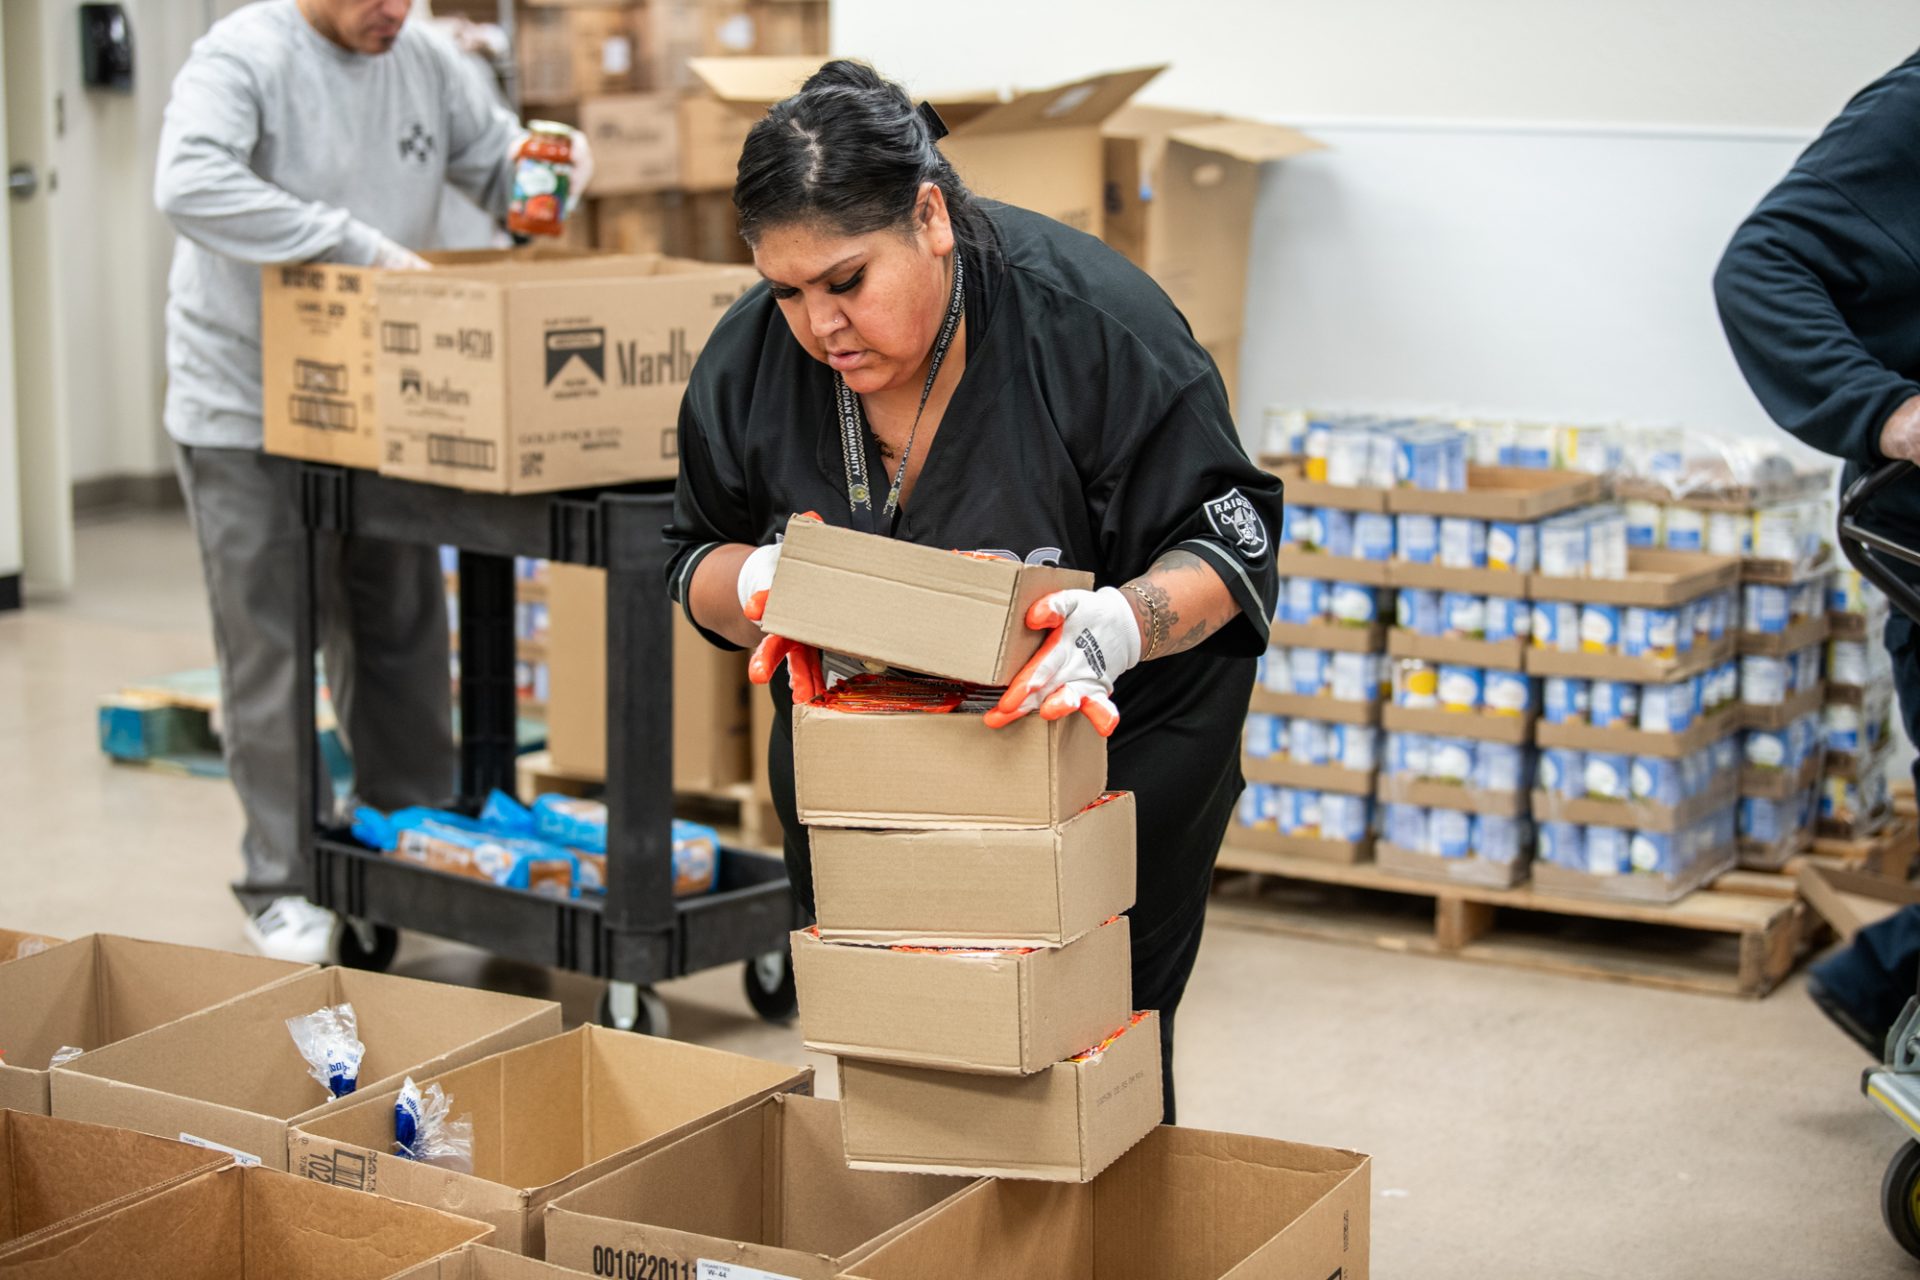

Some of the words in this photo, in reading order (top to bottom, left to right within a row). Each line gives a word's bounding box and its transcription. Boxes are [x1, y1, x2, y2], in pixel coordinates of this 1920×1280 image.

[939, 314, 956, 349] INDIAN
[846, 416, 861, 477] COMMUNITY
[1081, 627, 1100, 652] FIRM
[707, 1269, 728, 1279] W-44
